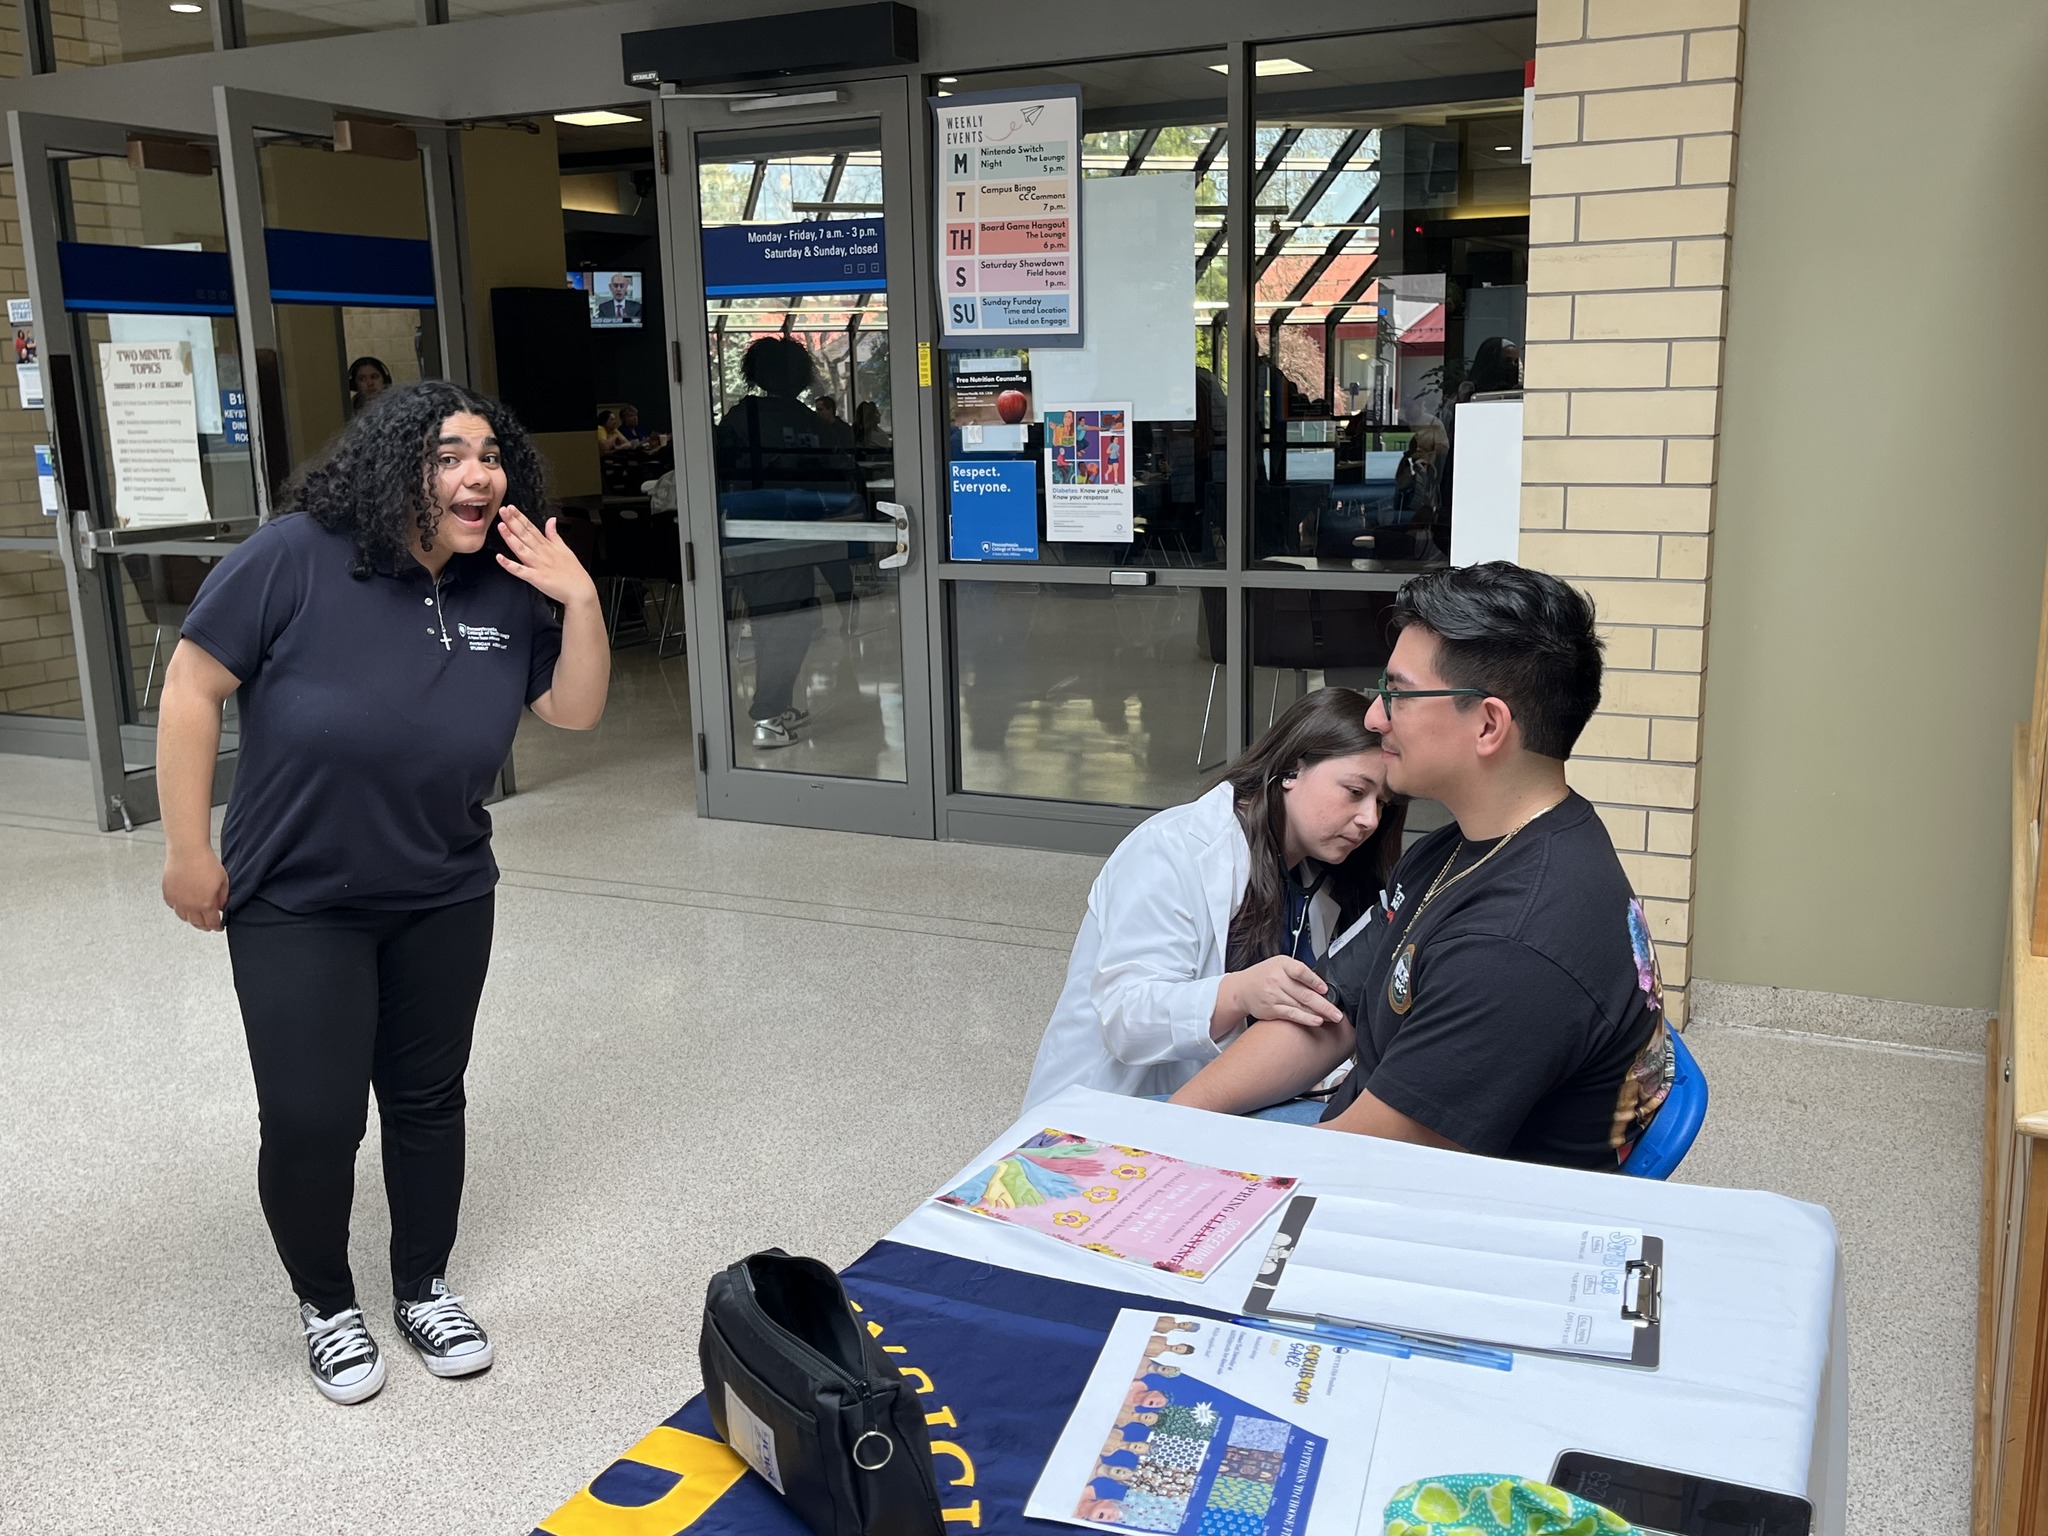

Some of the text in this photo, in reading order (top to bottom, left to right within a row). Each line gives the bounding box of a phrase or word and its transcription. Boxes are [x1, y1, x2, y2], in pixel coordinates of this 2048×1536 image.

[633, 73, 656, 81] STANLEY
[946, 115, 983, 129] WEEKLY
[947, 131, 983, 145] EVENTS
[981, 144, 1044, 156] Nintendo Switch
[954, 153, 967, 174] M
[981, 160, 1002, 169] Night
[1025, 154, 1065, 163] The Lounge
[1049, 165, 1065, 173] p.m.
[981, 184, 1036, 195] Campus Bingo
[956, 192, 966, 212] T
[1031, 193, 1066, 201] Commons
[1049, 204, 1066, 212] p.m.
[981, 221, 1066, 231] Board Game Hangout
[748, 232, 782, 243] Monday
[789, 229, 818, 241] Friday,
[819, 229, 824, 239] 7
[826, 230, 844, 239] a.m.
[852, 227, 858, 237] 3
[859, 228, 878, 239] p.m.
[950, 229, 972, 250] TH
[1026, 231, 1066, 239] The Lounge
[764, 243, 878, 259] Saturday & Sunday, closed
[1050, 242, 1066, 250] p.m.
[981, 259, 1064, 270] Saturday Showdown
[956, 267, 967, 287] S
[1027, 269, 1043, 277] Field
[1049, 280, 1066, 288] p.m.
[982, 297, 1041, 307] Sunday Funday
[953, 303, 975, 324] SU
[1041, 317, 1066, 326] Engage
[116, 348, 172, 361] TWO MINUTE
[130, 362, 162, 374] TOPICS
[995, 375, 1027, 383] Counseling
[952, 465, 1000, 480] Respect.
[953, 480, 1011, 496] Everyone.
[1222, 1182, 1262, 1214] SPRING
[1129, 1221, 1147, 1233] PM
[1188, 1217, 1241, 1265] SCREENING
[1603, 1232, 1636, 1267] Scrub
[1285, 1343, 1305, 1368] SALE
[1293, 1345, 1322, 1404] SCRUB CAP
[1296, 1445, 1314, 1484] PATTERNS
[1292, 1484, 1305, 1495] TO
[1283, 1494, 1301, 1528] CHOOSE
